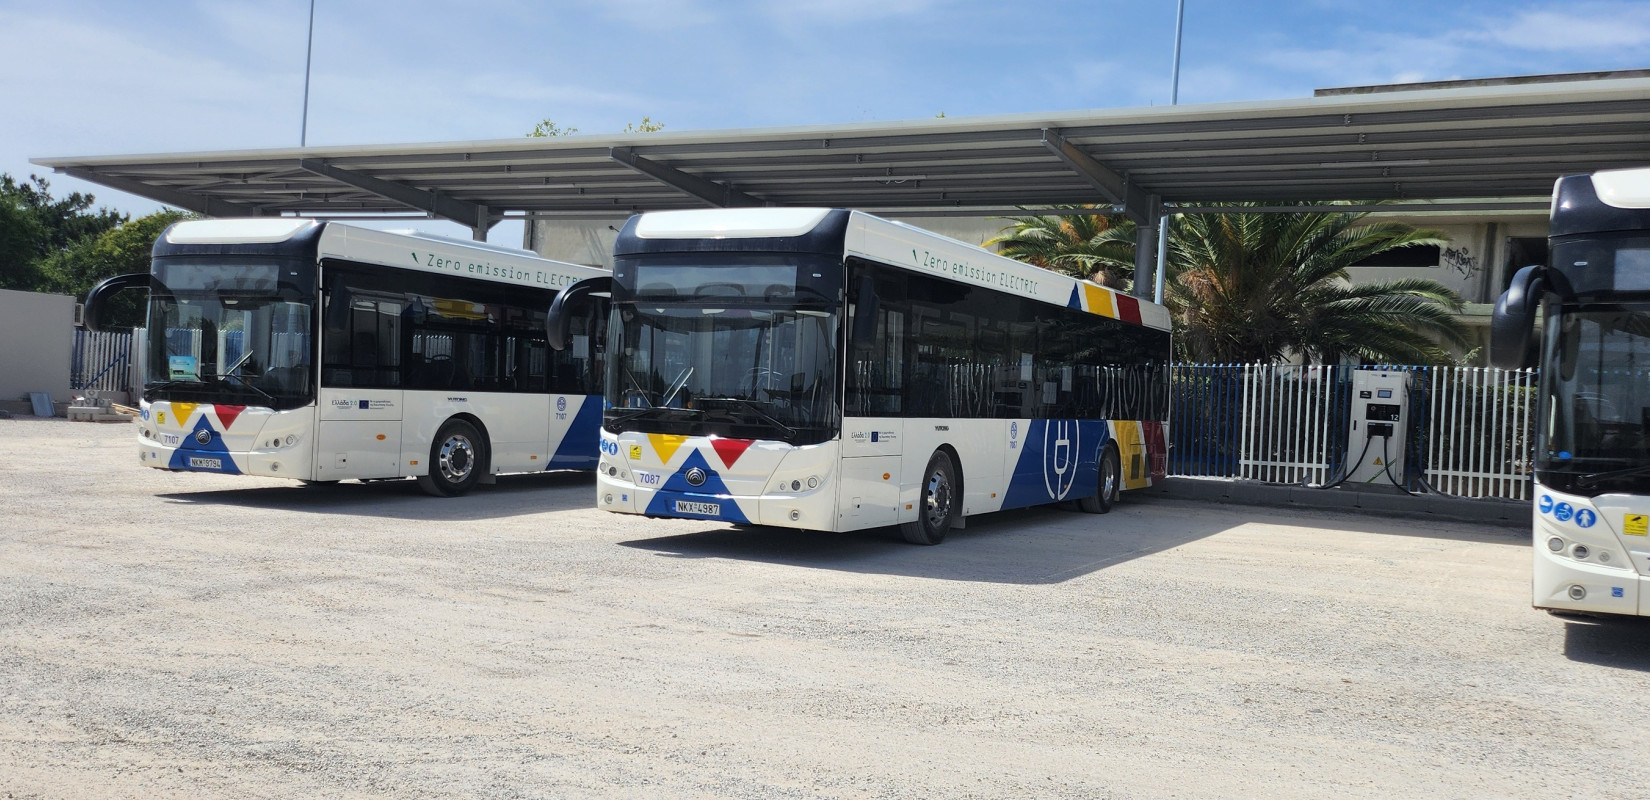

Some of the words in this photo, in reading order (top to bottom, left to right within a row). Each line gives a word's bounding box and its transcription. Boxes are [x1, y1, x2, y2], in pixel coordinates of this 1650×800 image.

[427, 253, 461, 270] Zero
[468, 263, 530, 280] emission
[536, 271, 583, 287] ELECTR
[923, 251, 948, 271] Zero
[952, 262, 996, 282] emission
[999, 272, 1038, 295] ELECTRIC
[164, 435, 179, 444] 7107
[640, 473, 660, 485] 7087
